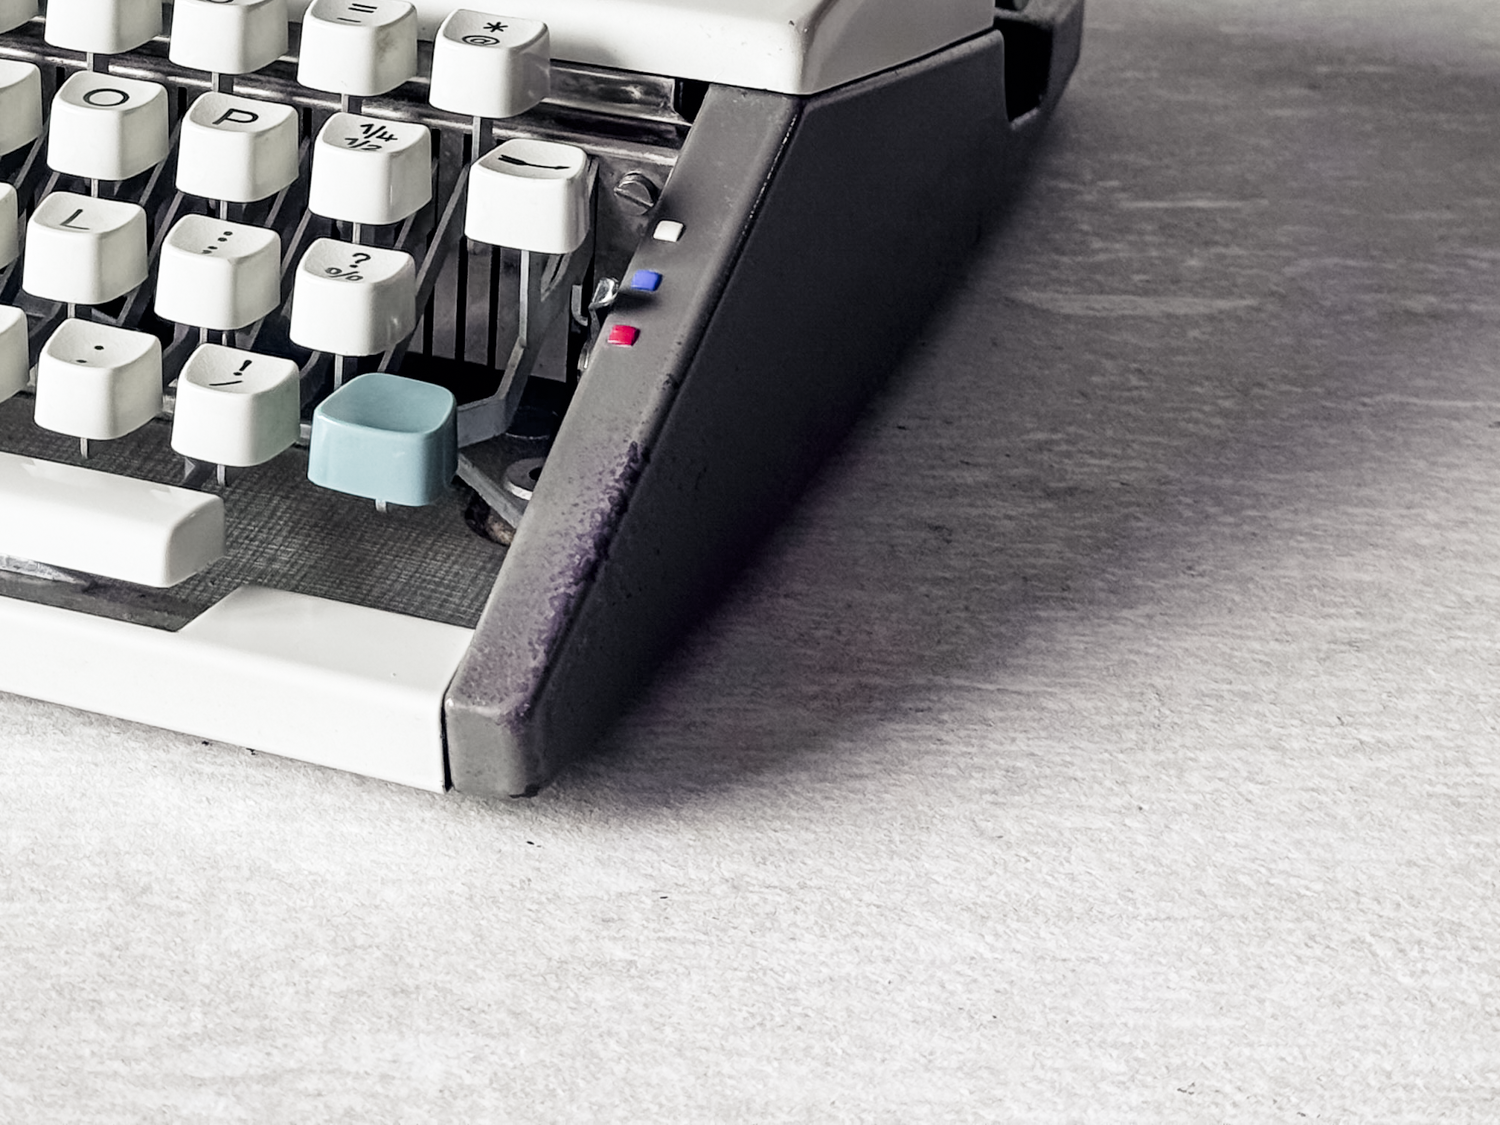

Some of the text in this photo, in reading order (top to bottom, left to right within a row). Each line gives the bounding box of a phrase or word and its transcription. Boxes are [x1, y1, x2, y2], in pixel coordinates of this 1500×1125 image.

[462, 35, 500, 46] @
[211, 108, 259, 128] P
[360, 123, 398, 142] 1/4
[345, 138, 382, 151] 1/2
[60, 209, 90, 231] L
[350, 253, 371, 269] ?
[325, 267, 364, 281] %
[233, 359, 252, 376] !
